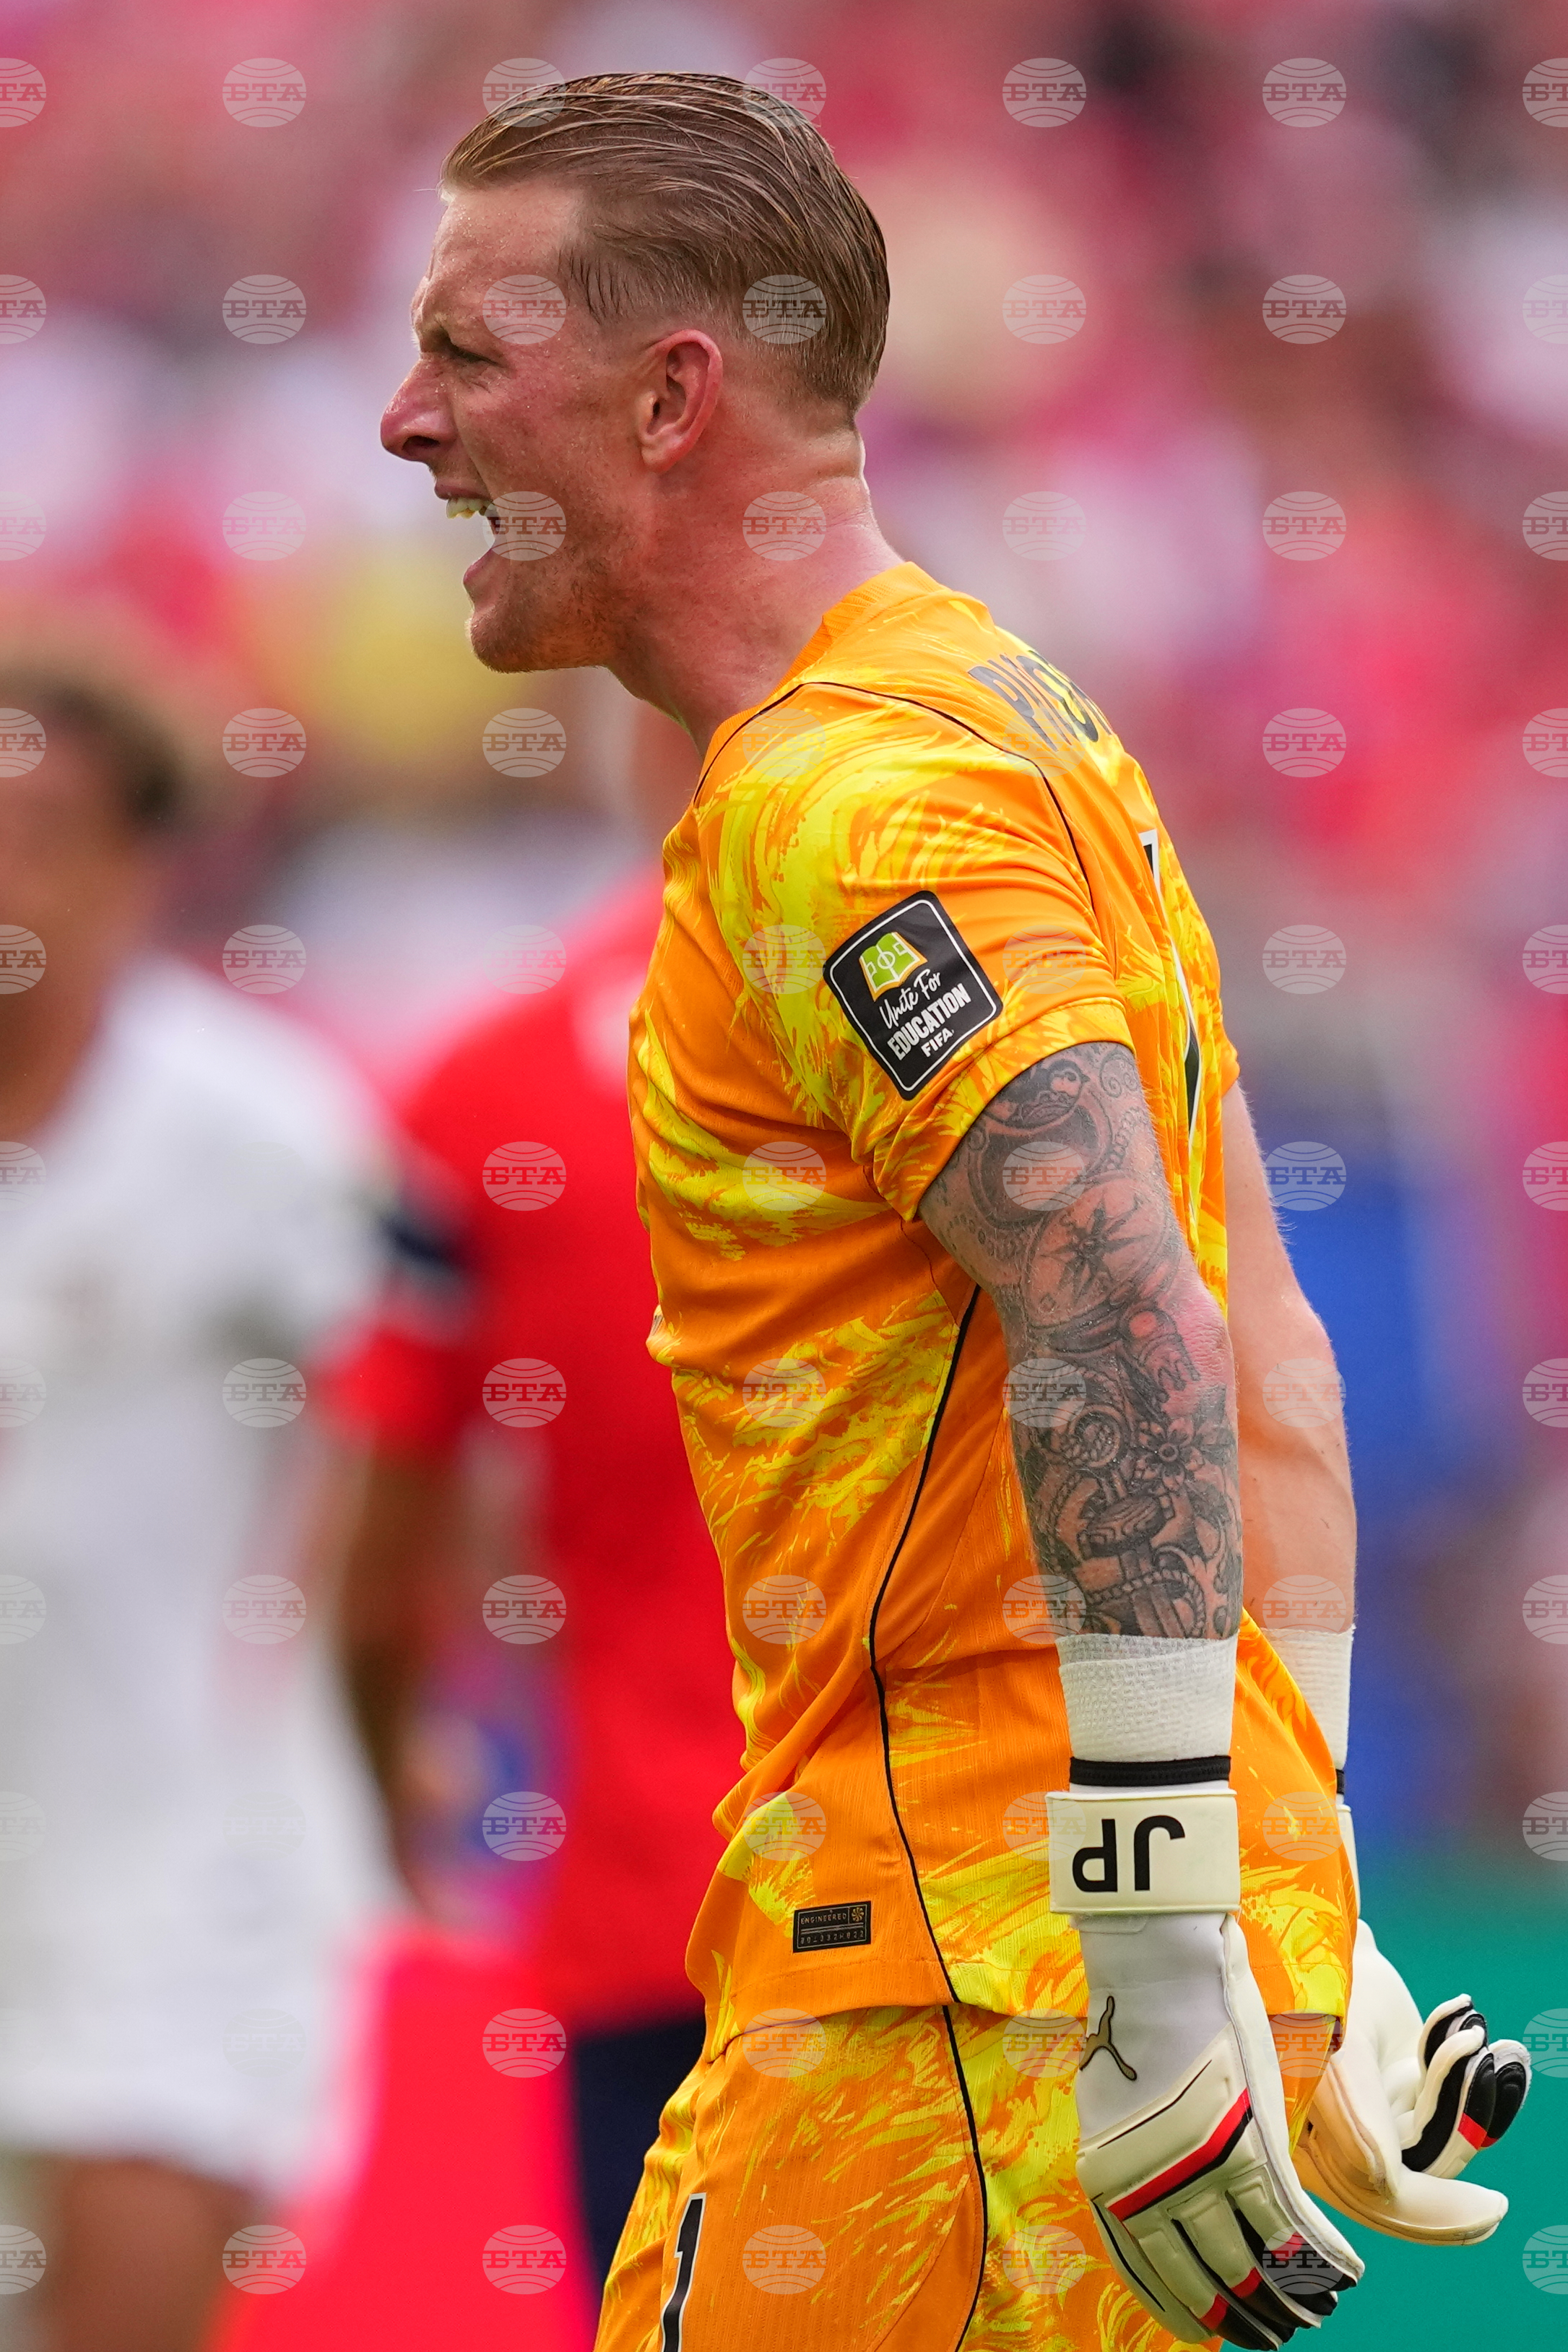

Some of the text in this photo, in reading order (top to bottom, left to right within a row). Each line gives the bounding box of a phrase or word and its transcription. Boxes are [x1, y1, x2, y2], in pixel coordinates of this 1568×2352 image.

[879, 968, 941, 1029] Unite For
[887, 982, 971, 1061] EDUCATION
[920, 1027, 953, 1058] FIFA
[1072, 1815, 1185, 1893] JP
[800, 1913, 847, 1925] ENGINEERED
